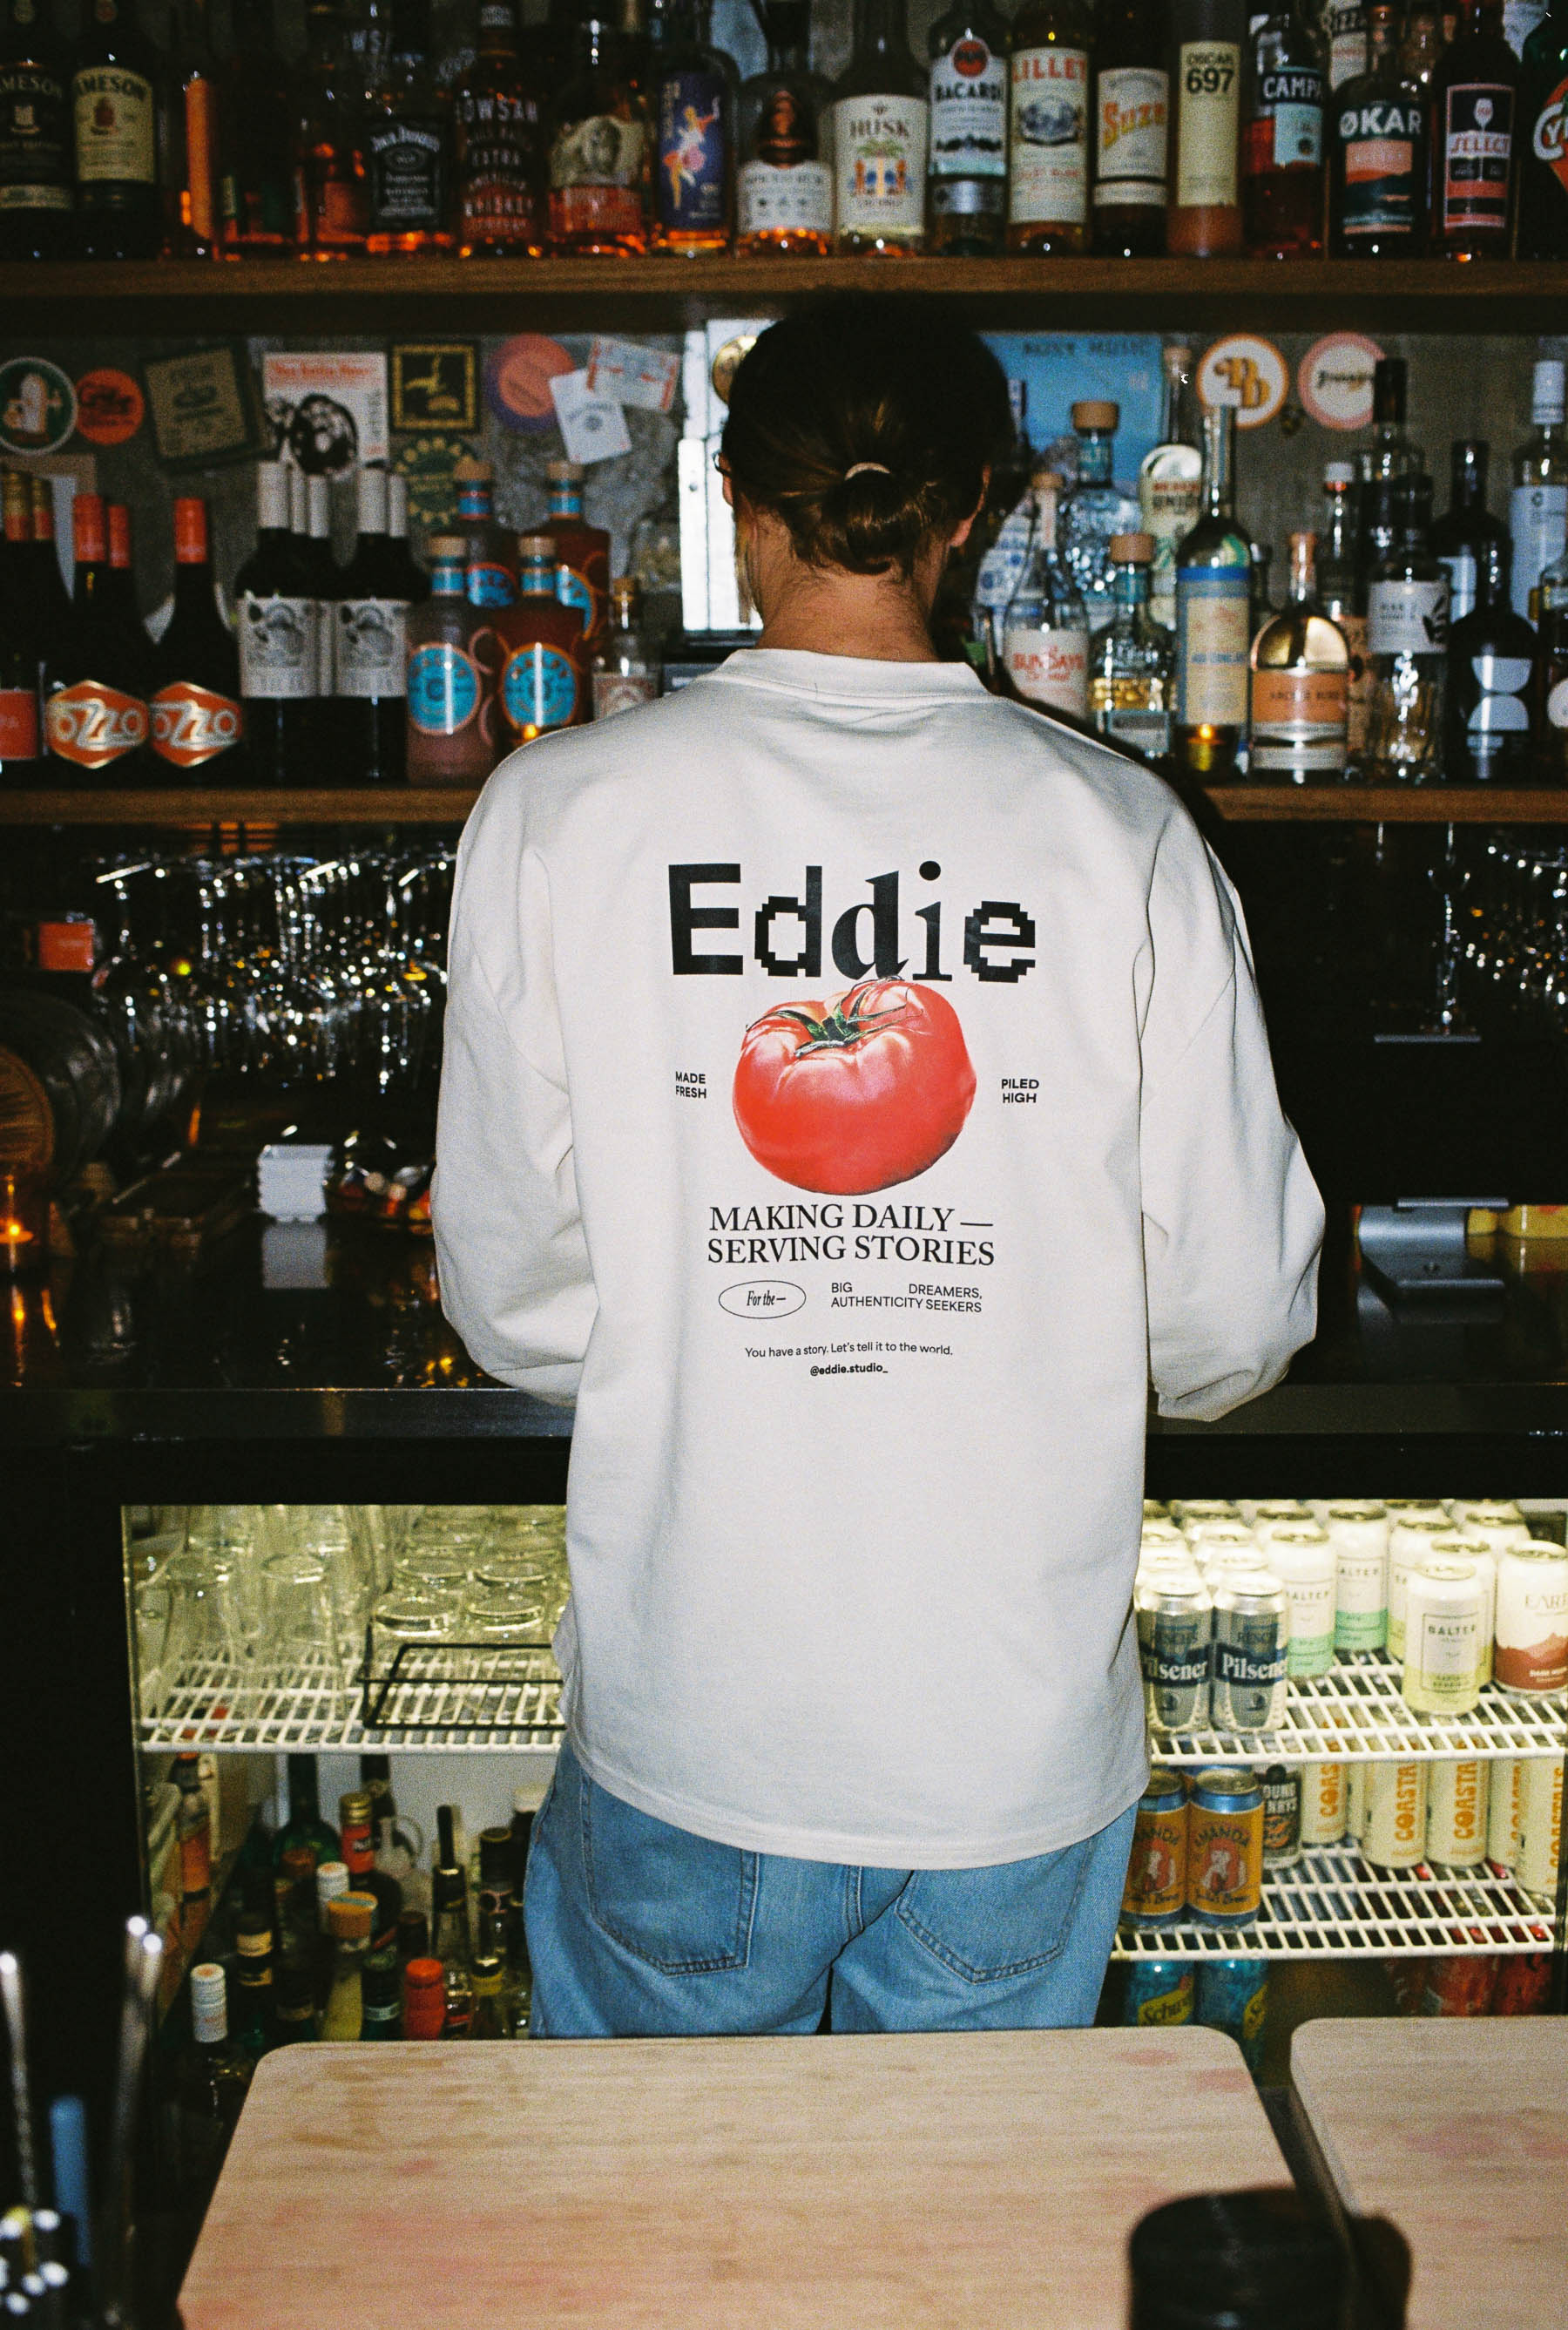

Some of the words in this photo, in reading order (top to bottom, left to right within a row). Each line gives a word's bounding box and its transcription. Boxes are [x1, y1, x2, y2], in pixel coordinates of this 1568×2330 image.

[1186, 67, 1234, 95] 697
[668, 860, 1036, 984] Eddie
[675, 1071, 706, 1085] MADE
[1001, 1078, 1040, 1089] PILED
[675, 1086, 707, 1100] FRESH
[1003, 1092, 1037, 1104] HIGH
[709, 1203, 844, 1231] MAKING
[852, 1203, 956, 1232] DAILY
[707, 1235, 847, 1263] SERVING
[855, 1235, 995, 1266] STORIES
[747, 1290, 761, 1306] For
[831, 1282, 853, 1293] BIG
[909, 1284, 983, 1299] DREAMERS,
[830, 1296, 923, 1309] AUTHENTICITY
[925, 1298, 983, 1313] SEEKERS
[745, 1347, 766, 1358] You
[769, 1347, 794, 1358] have
[803, 1346, 829, 1357] story.
[856, 1341, 873, 1352] tell
[875, 1341, 883, 1351] it
[885, 1342, 897, 1352] to
[899, 1342, 917, 1352] the
[919, 1344, 954, 1356] world.
[809, 1362, 889, 1377] @eddie.studio_
[1143, 1656, 1207, 1680] ilsener
[1394, 1760, 1416, 1842] COASTA
[1452, 1758, 1477, 1839] COASTA
